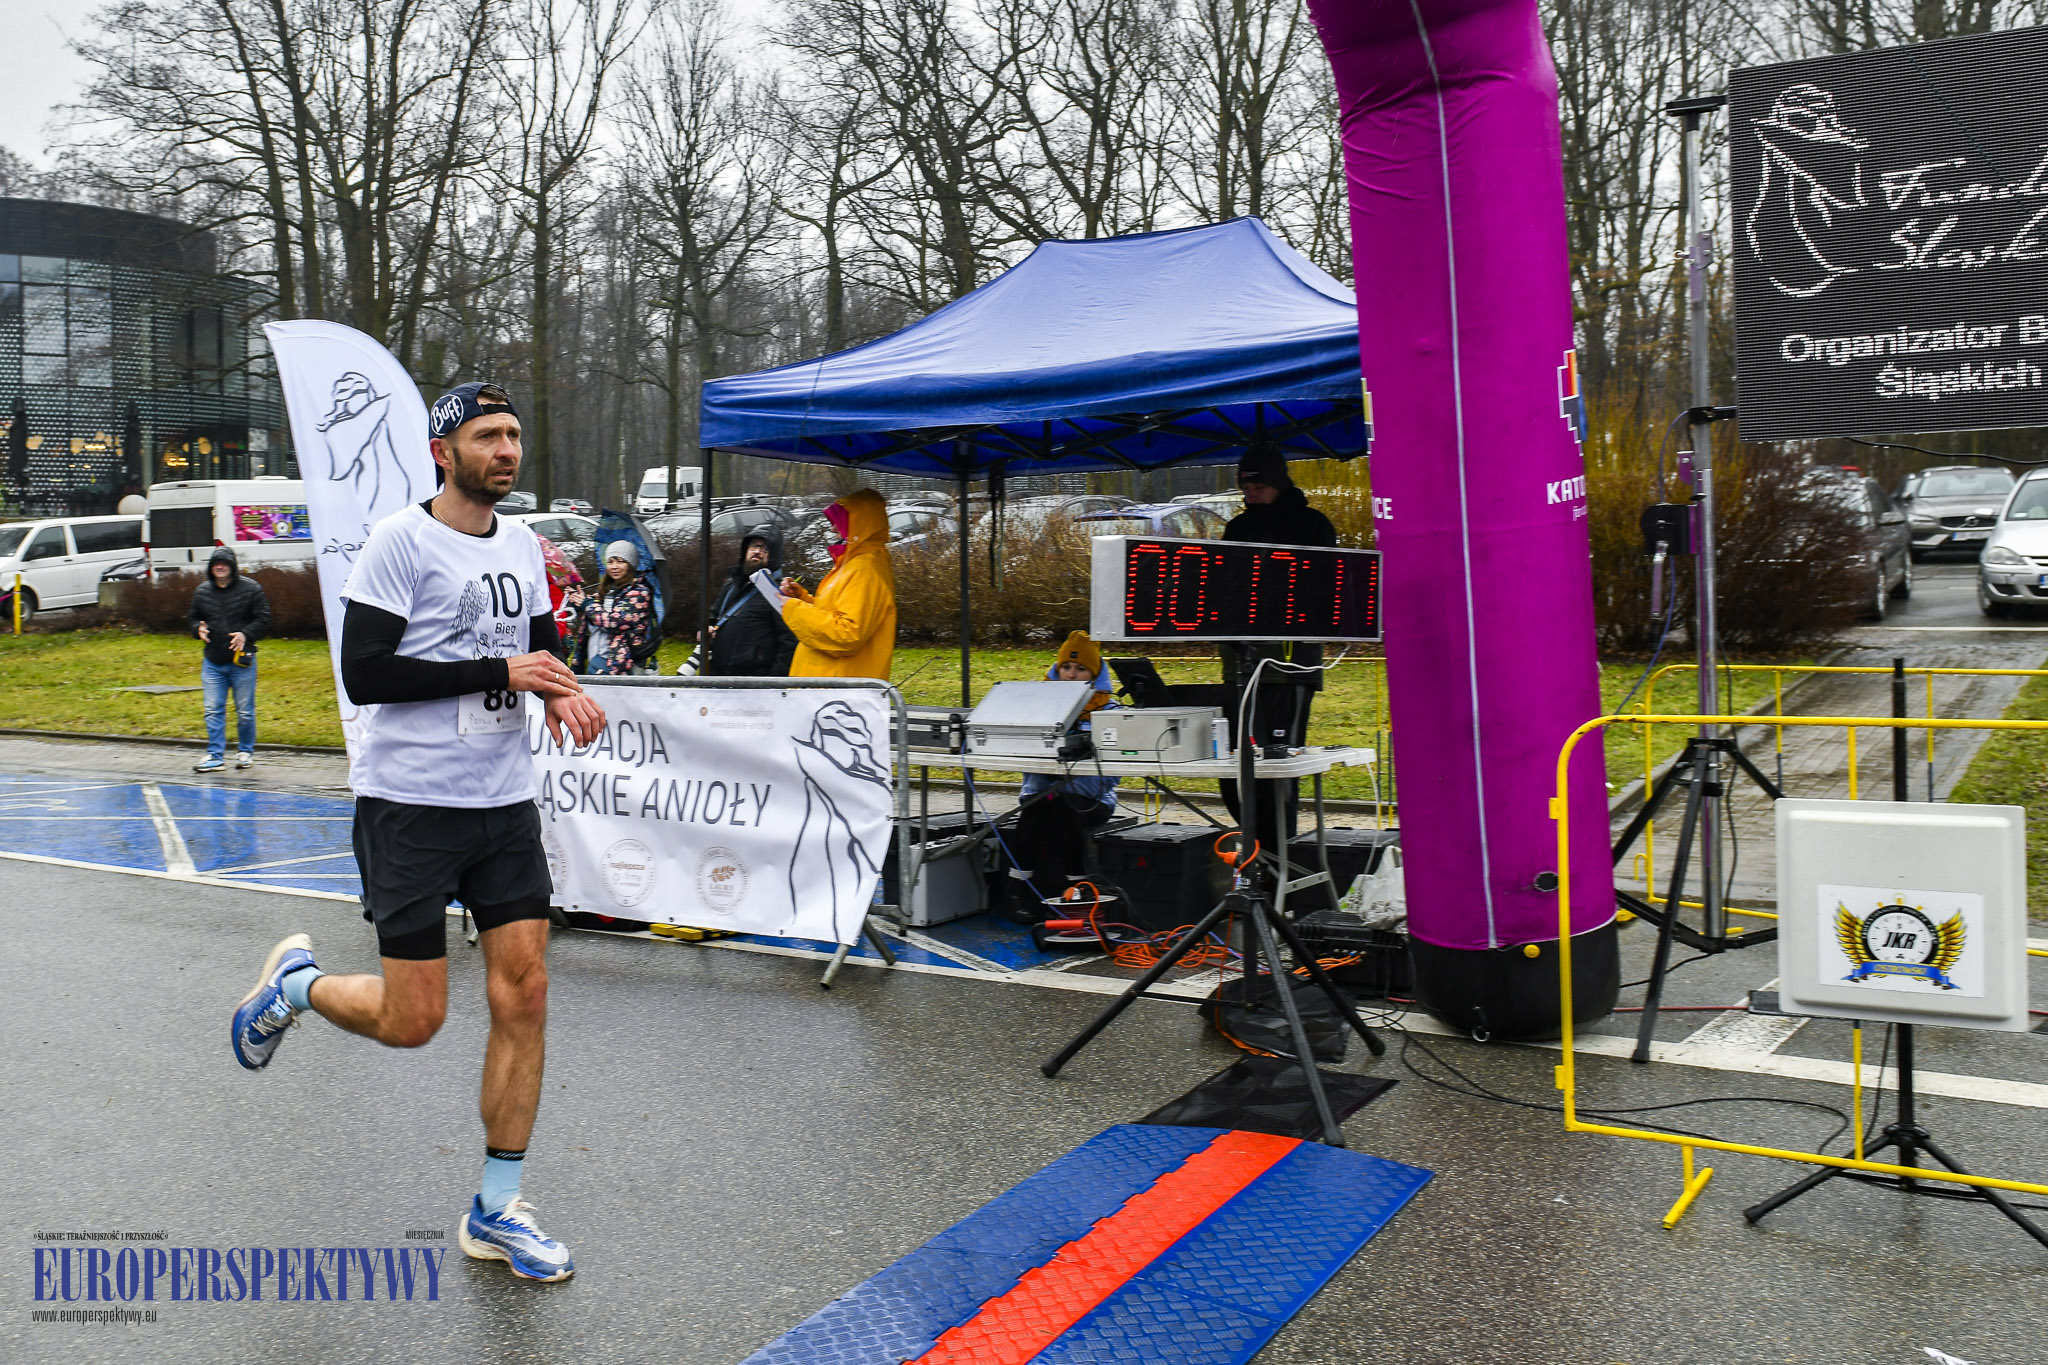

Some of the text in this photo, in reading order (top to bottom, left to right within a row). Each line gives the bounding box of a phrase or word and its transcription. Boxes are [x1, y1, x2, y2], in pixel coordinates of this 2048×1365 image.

[1780, 314, 2048, 366] Organizator B
[481, 572, 523, 619] 10
[1125, 544, 1378, 631] 00:17:11
[494, 622, 517, 637] Bieg
[483, 689, 519, 712] 88
[641, 777, 772, 828] ANIOŁY
[1882, 931, 1917, 949] JKR
